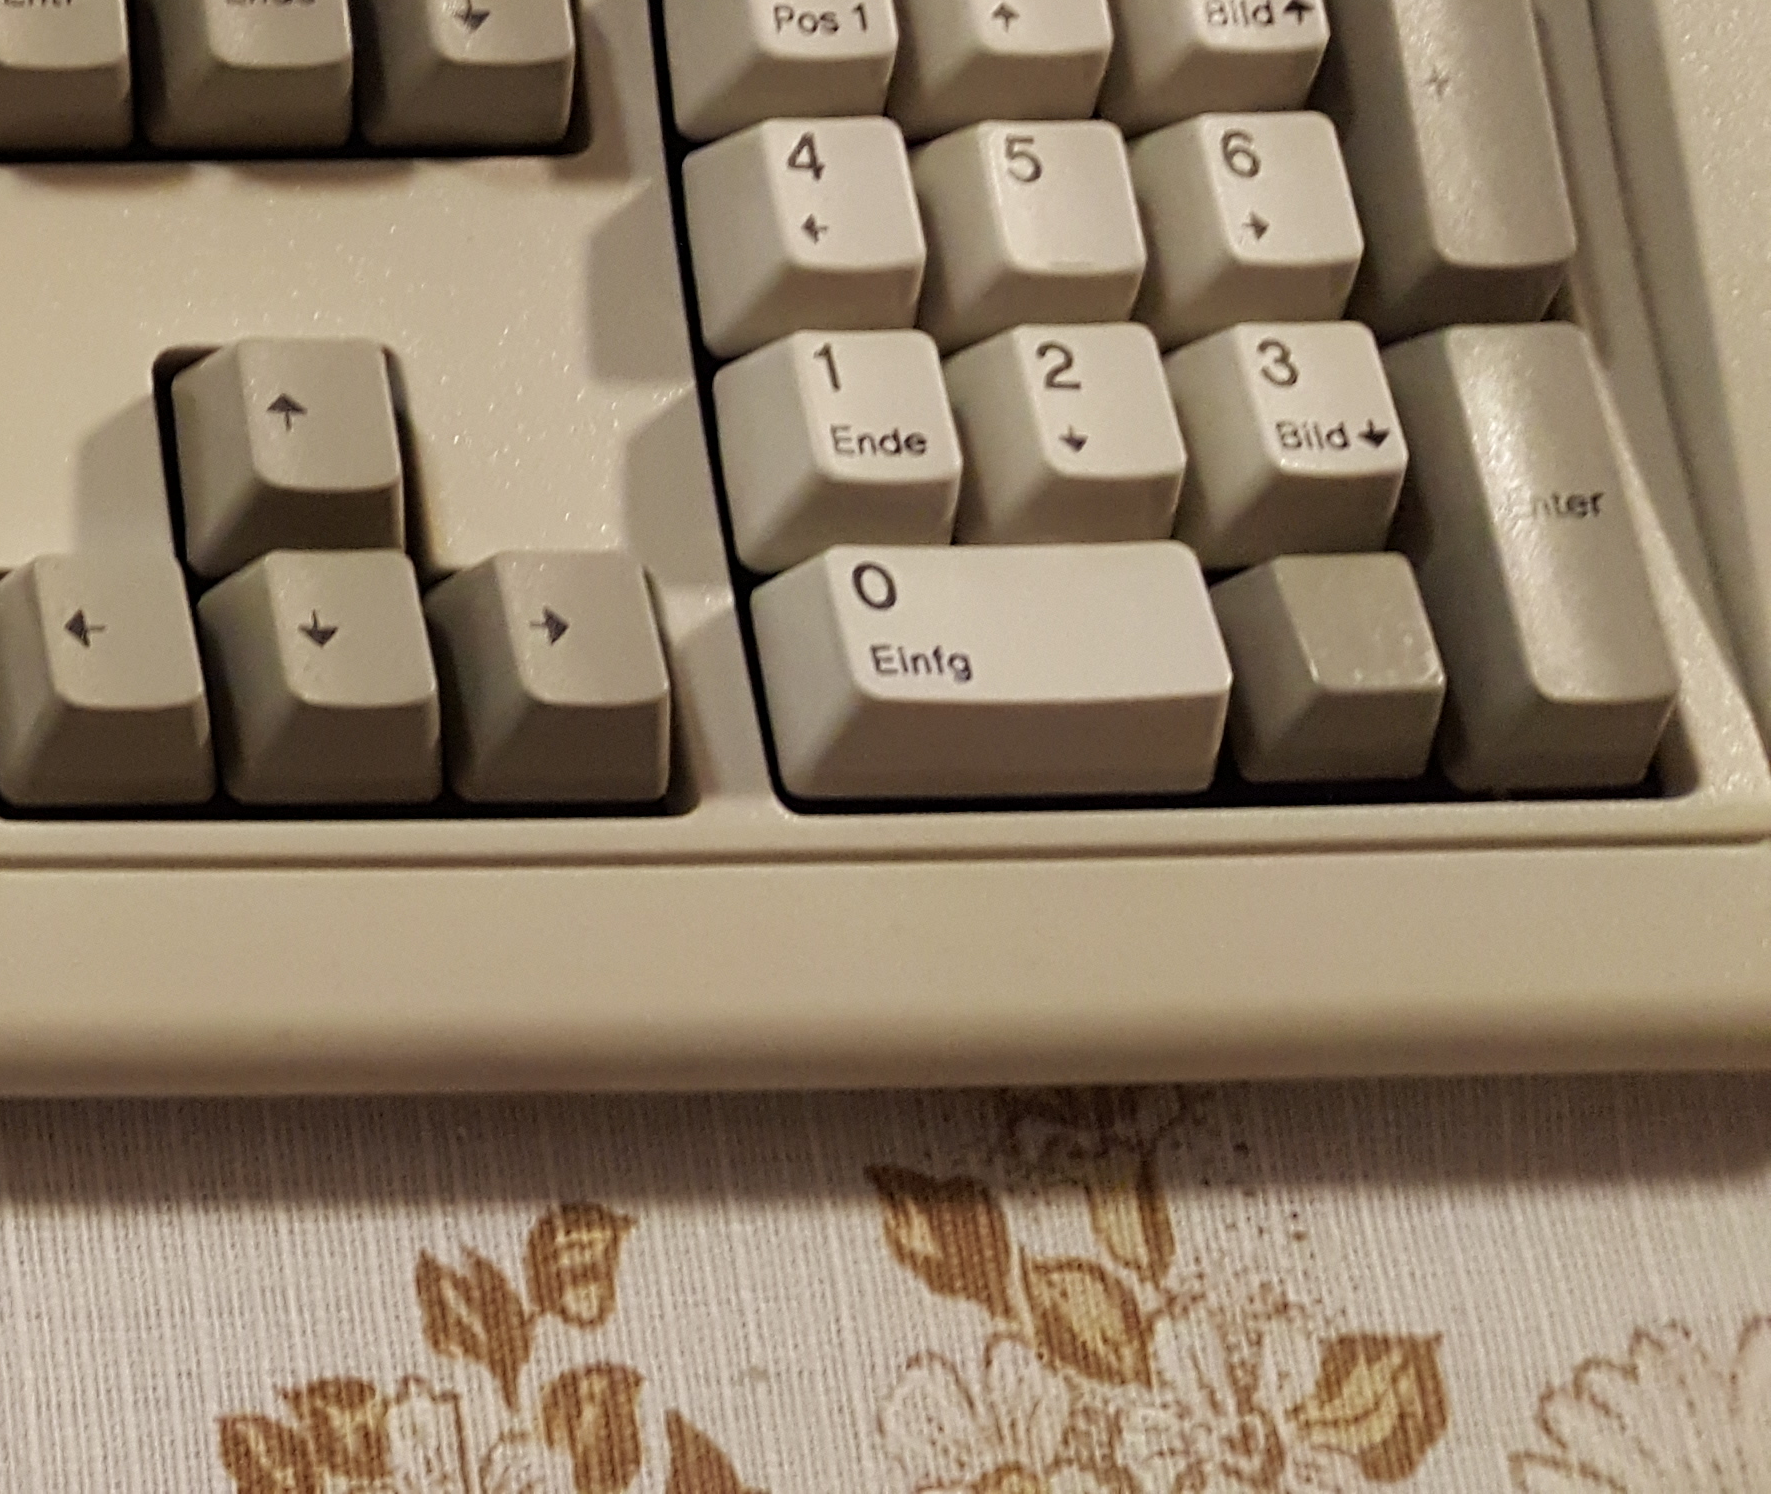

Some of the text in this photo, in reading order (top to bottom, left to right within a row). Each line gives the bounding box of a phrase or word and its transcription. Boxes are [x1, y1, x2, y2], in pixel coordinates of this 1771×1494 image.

[773, 2, 869, 36] Pos 1
[786, 132, 825, 181] 4
[1004, 135, 1043, 185] 5
[1220, 129, 1262, 180] 6
[813, 343, 841, 392] 1
[1035, 341, 1082, 391] 2
[1256, 338, 1300, 389] 3
[830, 425, 928, 457] Ende
[1275, 421, 1352, 452] Bild
[1509, 491, 1605, 519] nter
[869, 644, 974, 684] Einfg
